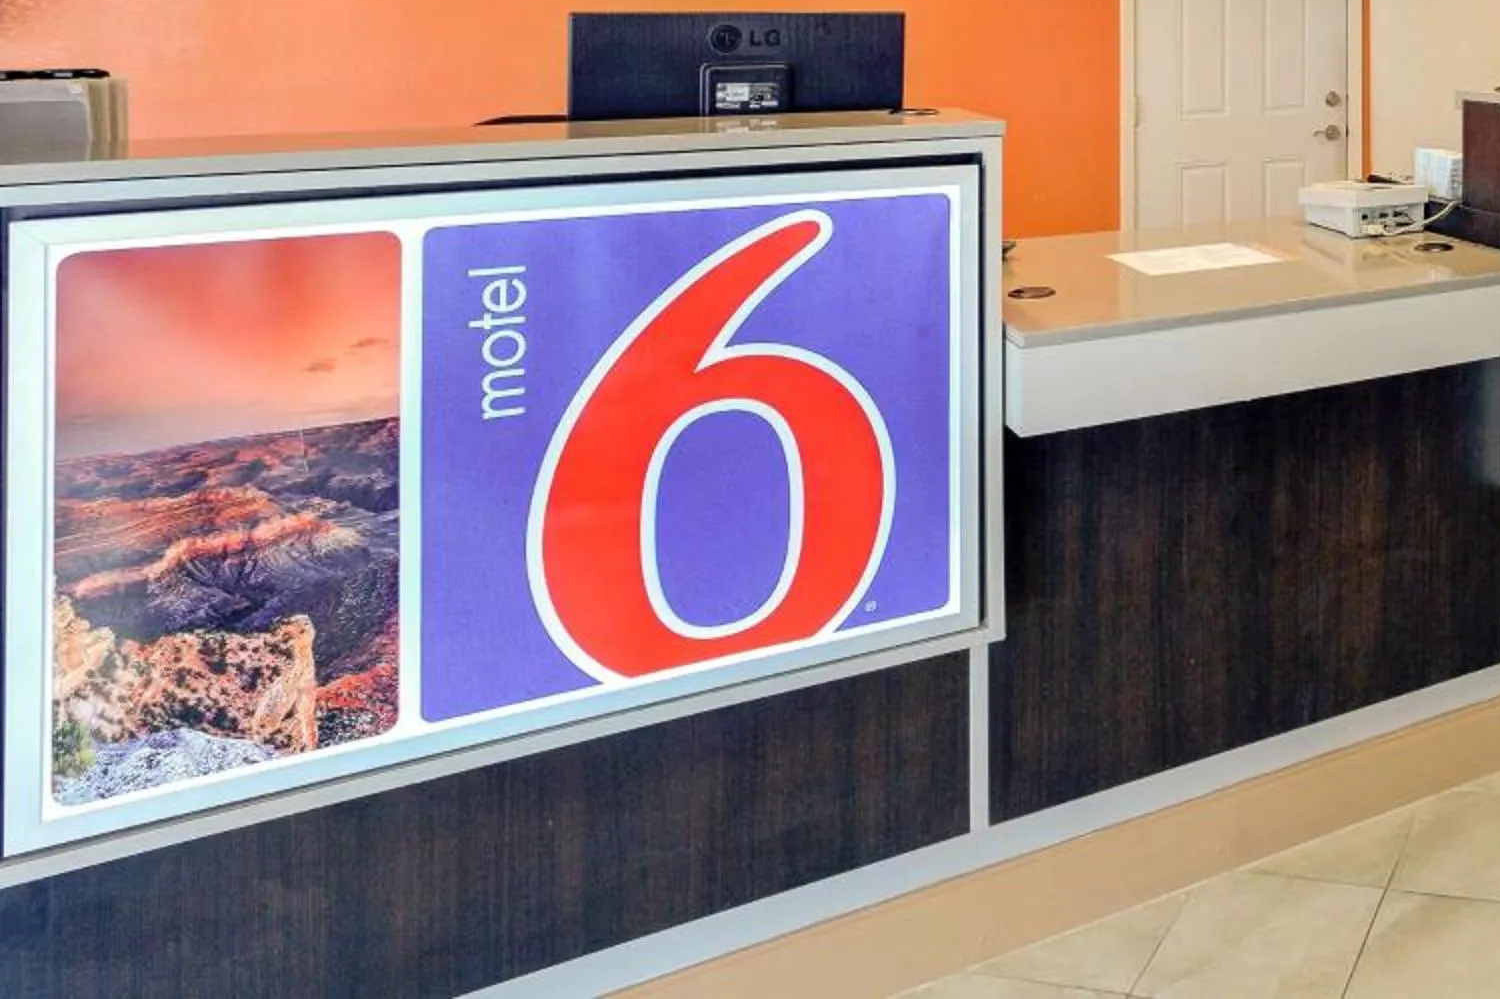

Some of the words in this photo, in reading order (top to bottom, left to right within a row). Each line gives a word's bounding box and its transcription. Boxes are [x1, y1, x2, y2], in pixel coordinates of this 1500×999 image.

[749, 29, 781, 47] LG
[468, 265, 527, 421] motel
[525, 208, 897, 685] 6
